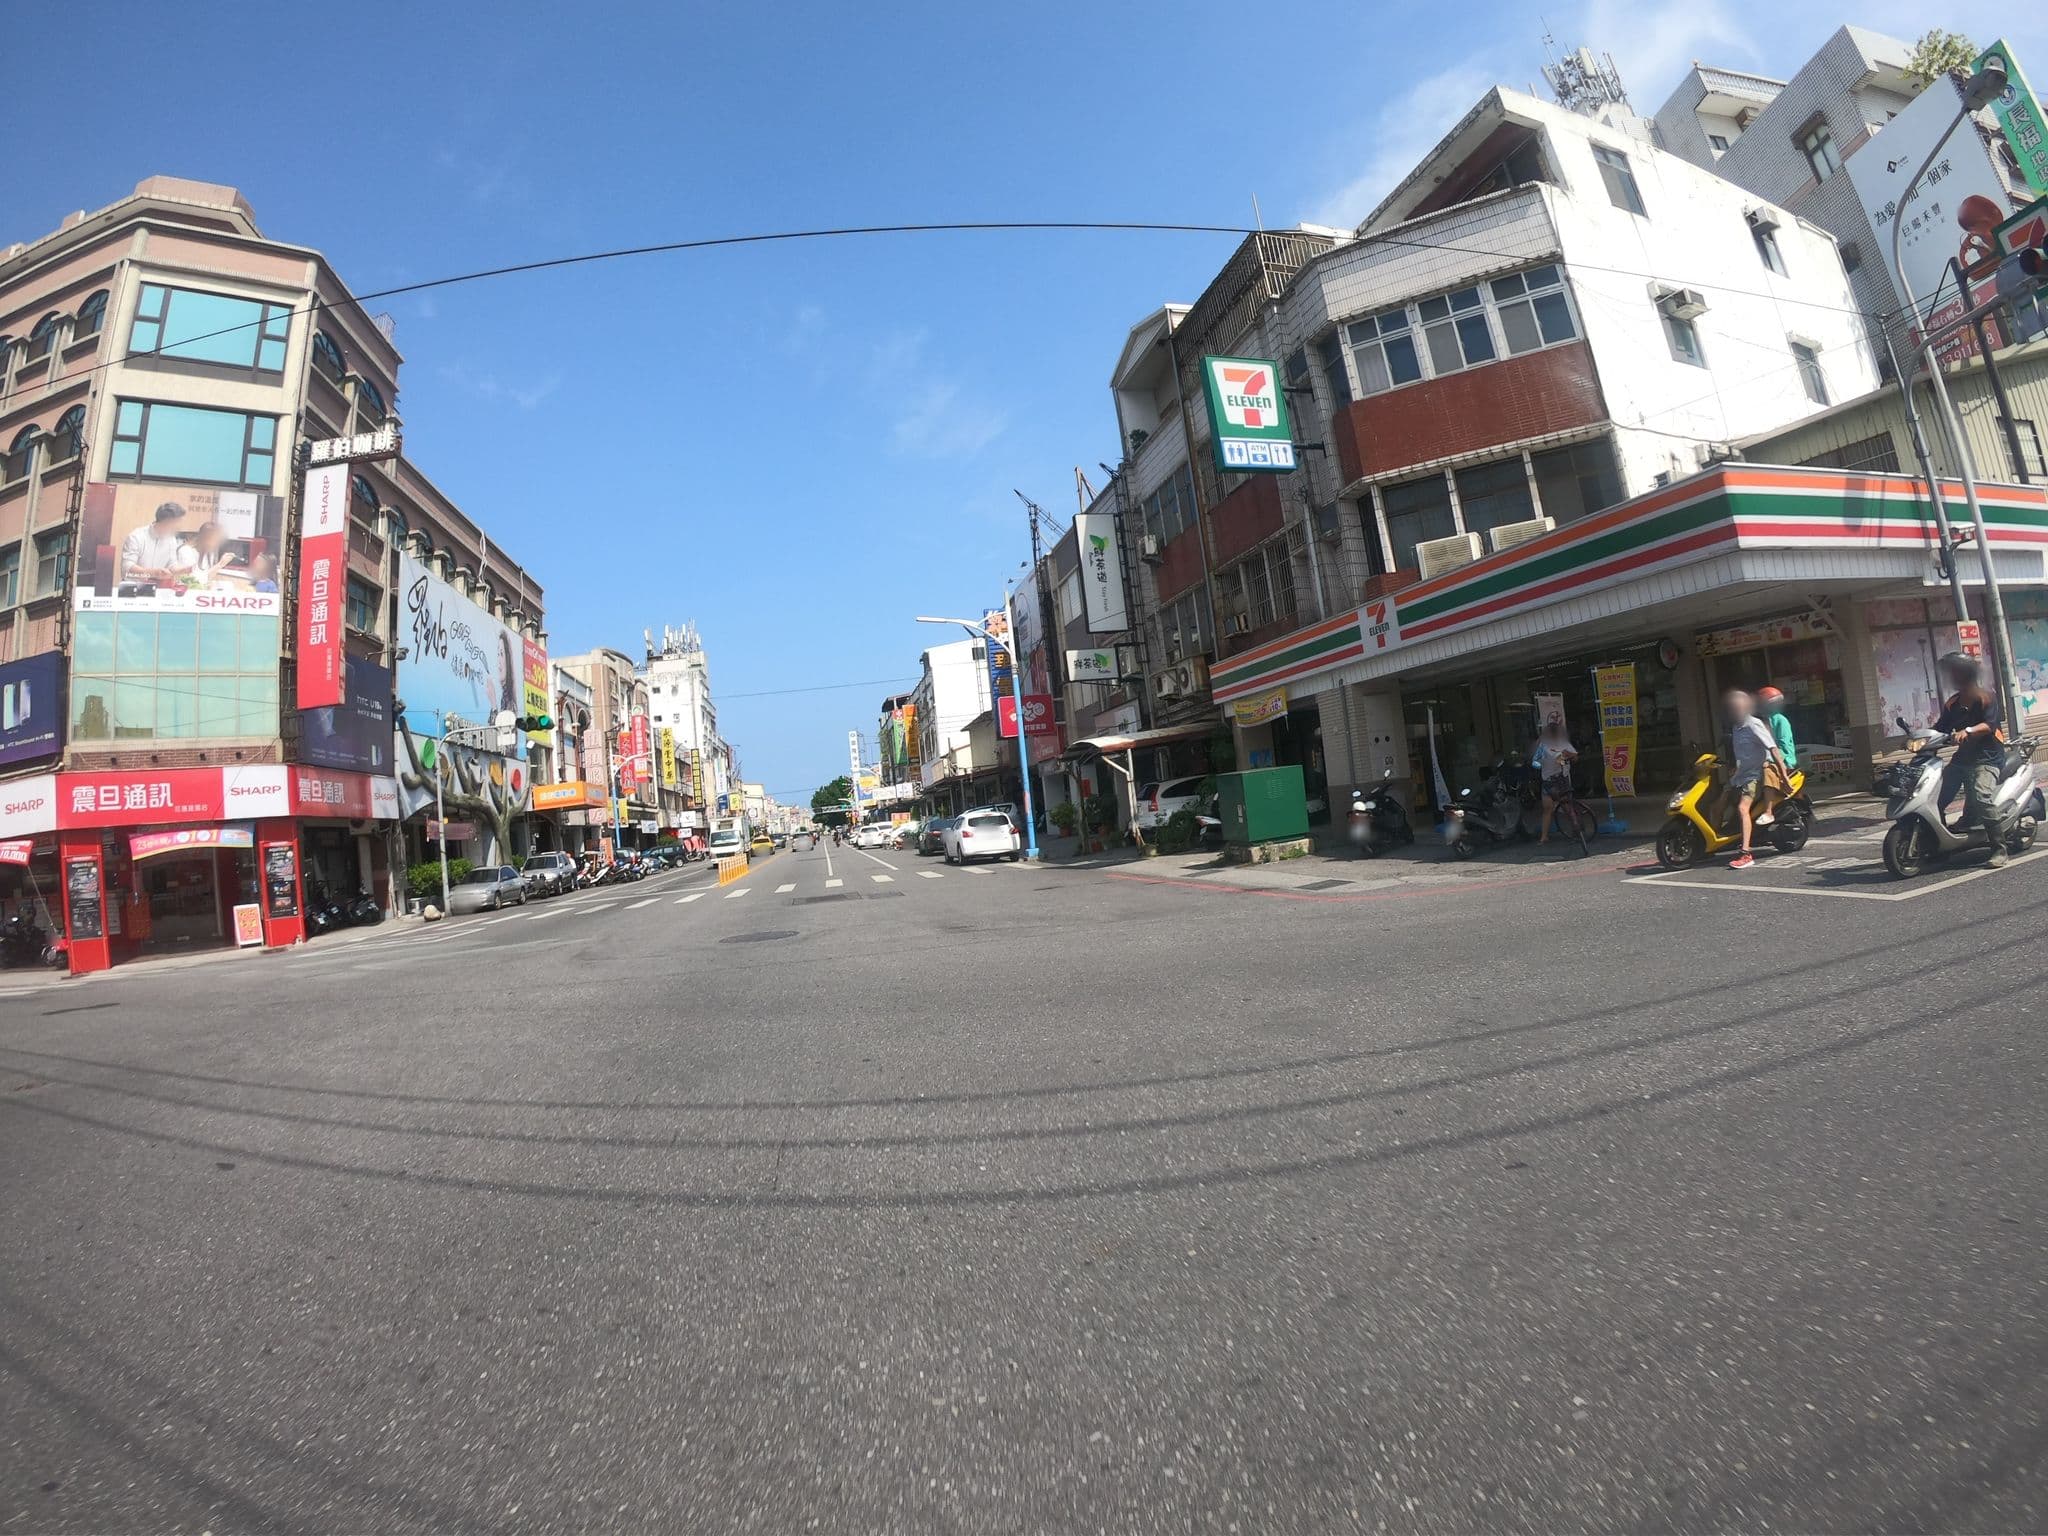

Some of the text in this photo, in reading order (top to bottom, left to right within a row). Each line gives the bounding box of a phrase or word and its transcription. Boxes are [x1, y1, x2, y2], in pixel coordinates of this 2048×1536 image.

[319, 474, 330, 525] SHARP
[195, 594, 273, 609] SHARP
[309, 558, 331, 645] 震旦通訊
[72, 782, 173, 814] 震旦通訊
[229, 784, 282, 798] SHARP
[298, 777, 345, 804] 震旦通訊
[374, 792, 396, 801] SHARP
[4, 798, 44, 815] SHARP
